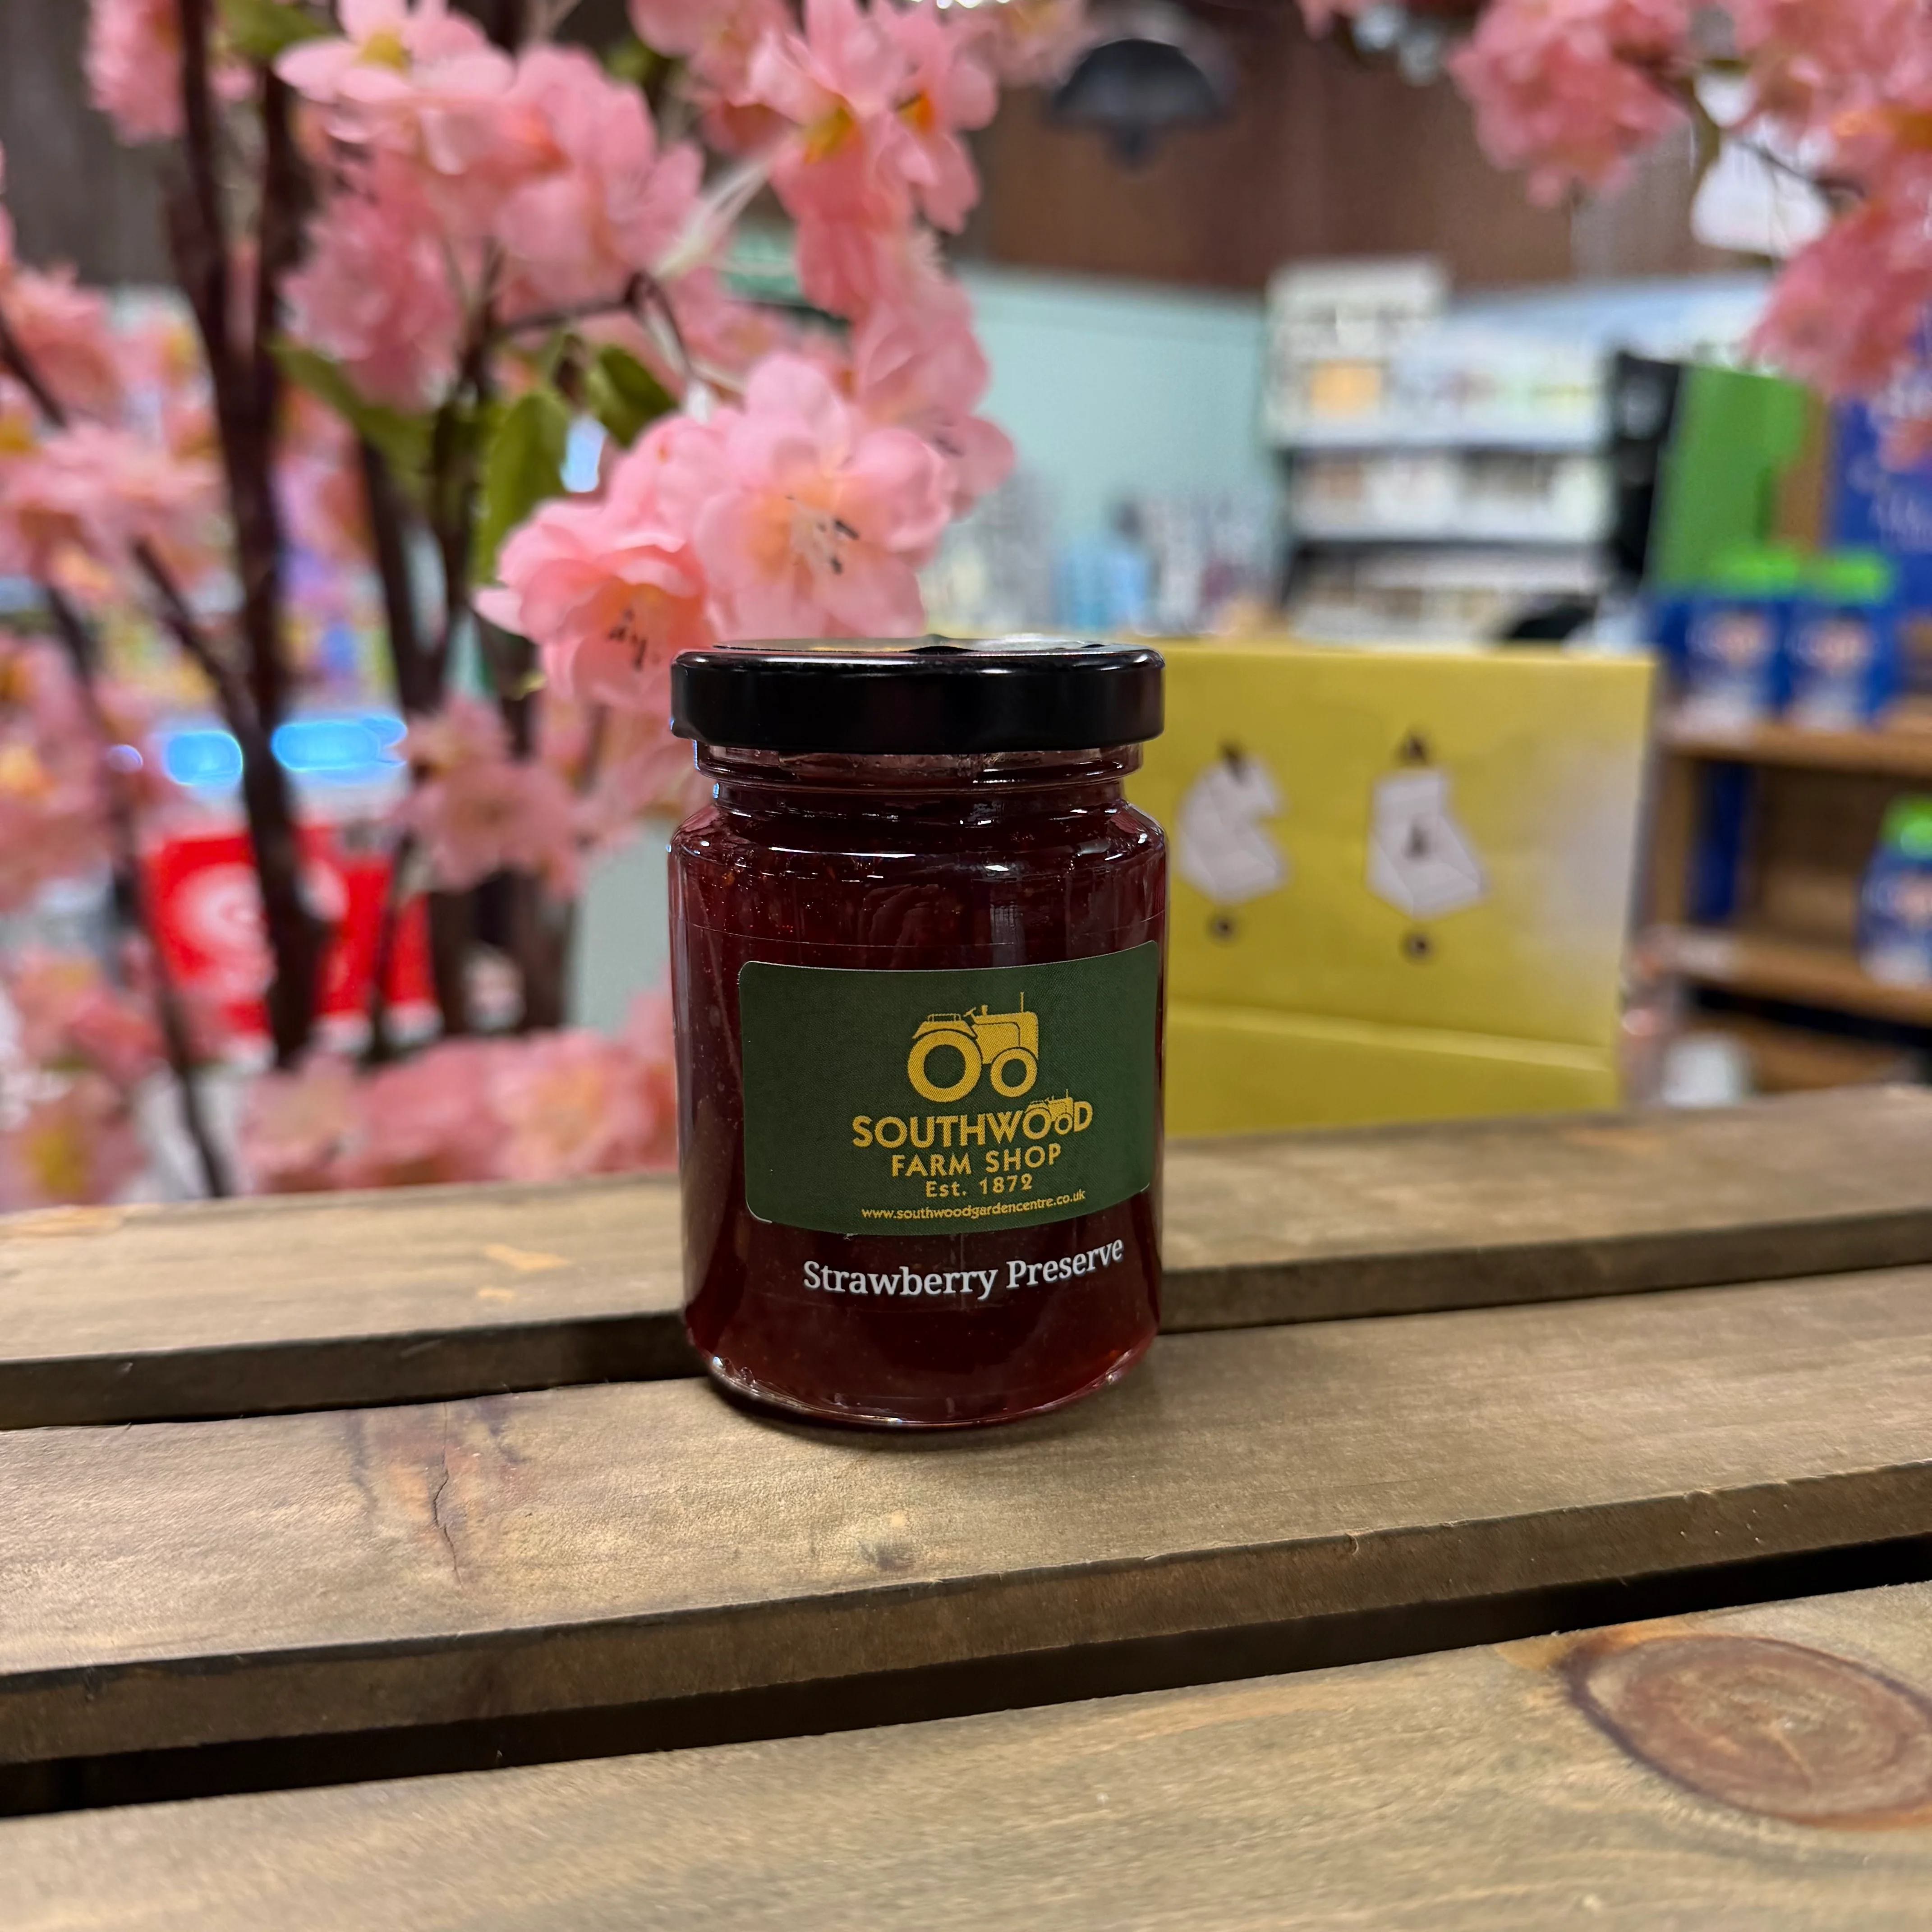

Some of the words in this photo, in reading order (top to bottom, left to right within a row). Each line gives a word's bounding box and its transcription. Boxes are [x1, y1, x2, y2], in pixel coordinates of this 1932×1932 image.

[852, 1101, 1093, 1148] SOUTHWOOD
[891, 1153, 972, 1177] FARM
[985, 1143, 1061, 1173] SHOP
[926, 1180, 966, 1197] Est.
[980, 1173, 1033, 1195] 1872
[862, 1189, 1086, 1219] www.southwoodgardencentre.co.uk
[803, 1261, 998, 1300] Strawberry
[1006, 1238, 1124, 1289] Preserve
